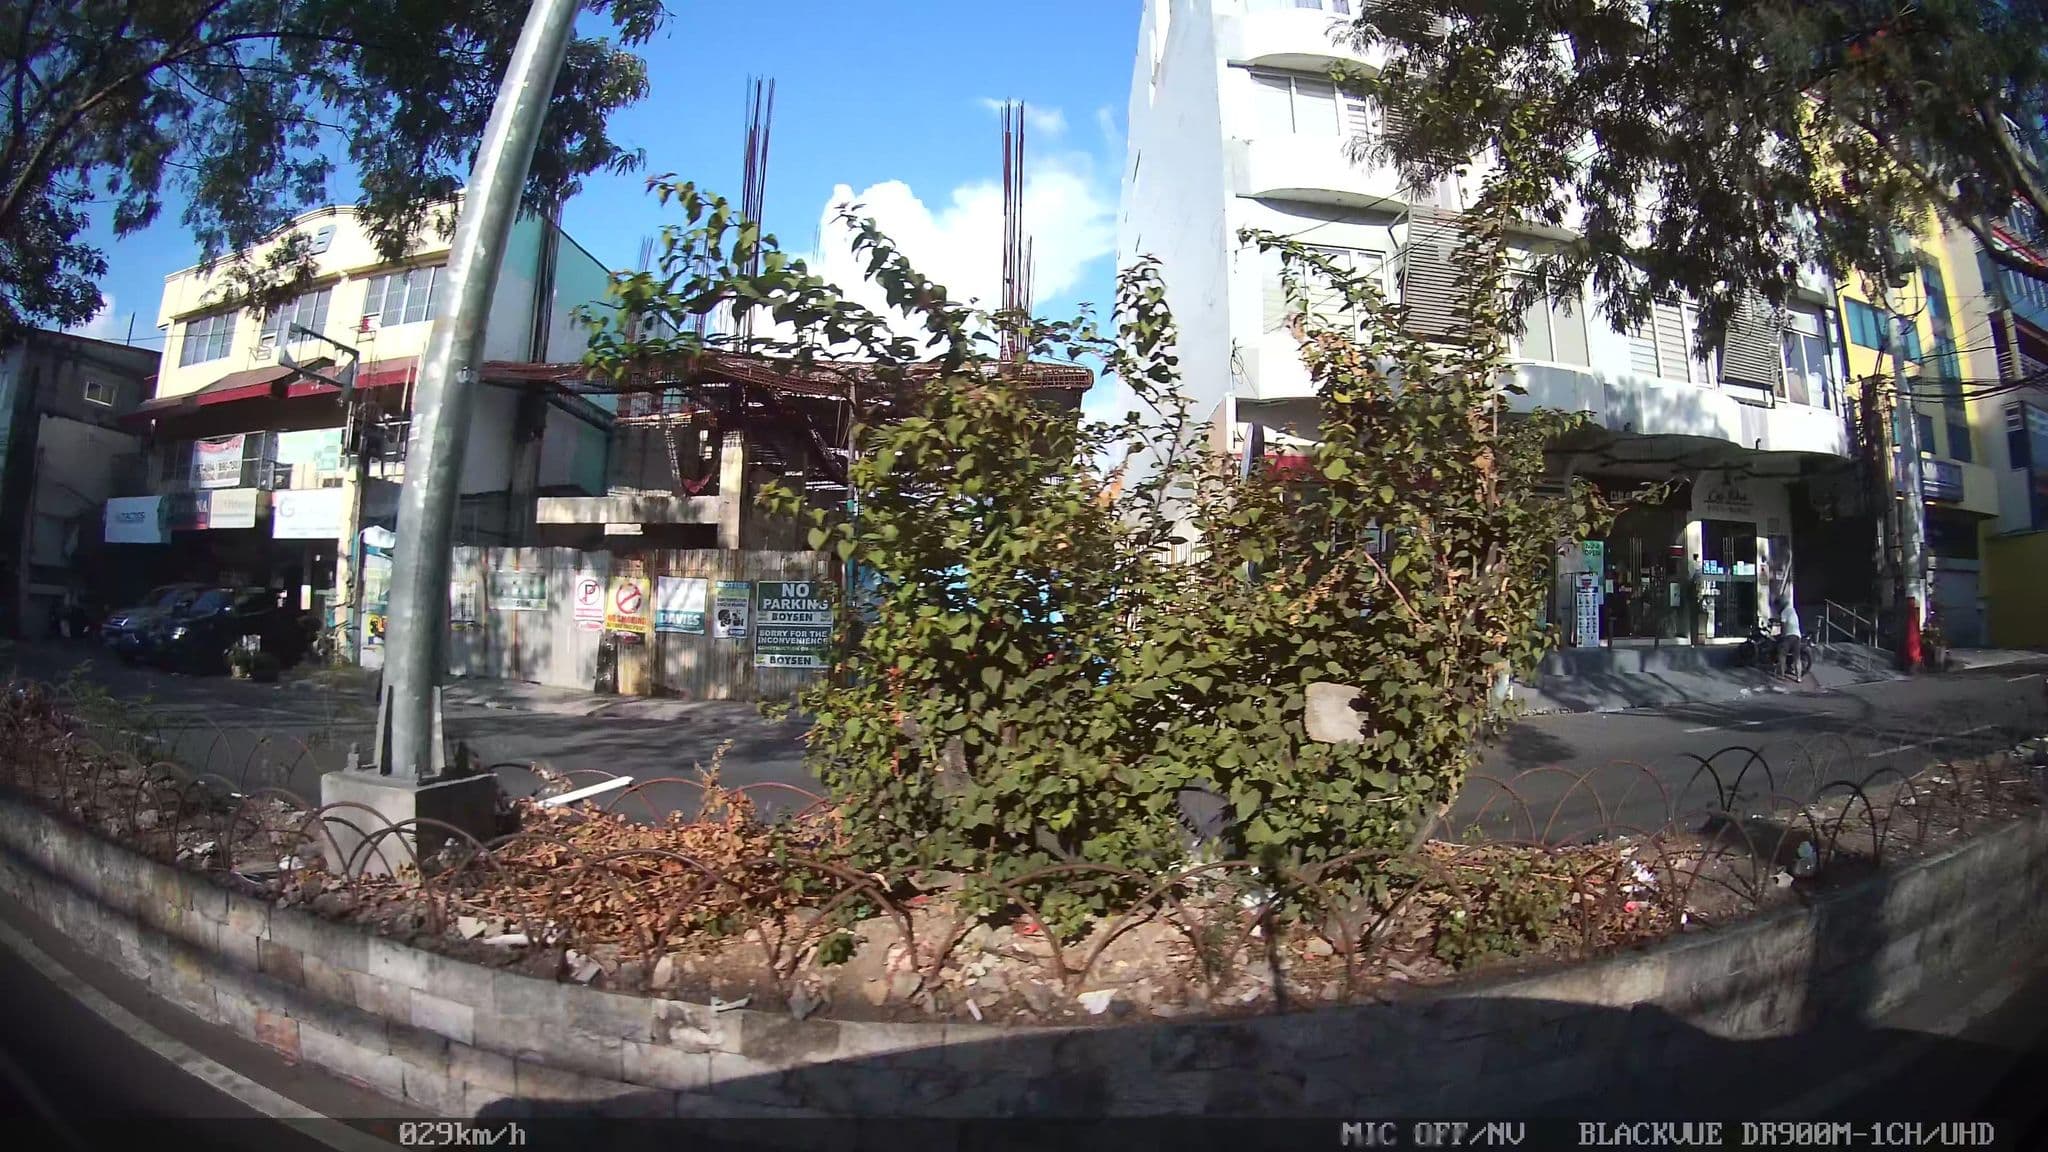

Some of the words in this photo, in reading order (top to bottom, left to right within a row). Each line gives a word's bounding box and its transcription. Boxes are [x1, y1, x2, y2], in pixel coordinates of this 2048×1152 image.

[782, 583, 810, 597] NO
[660, 612, 700, 626] DAVIES
[771, 612, 813, 622] BOYSEN
[809, 630, 828, 638] THE
[769, 655, 812, 665] BOYSEN
